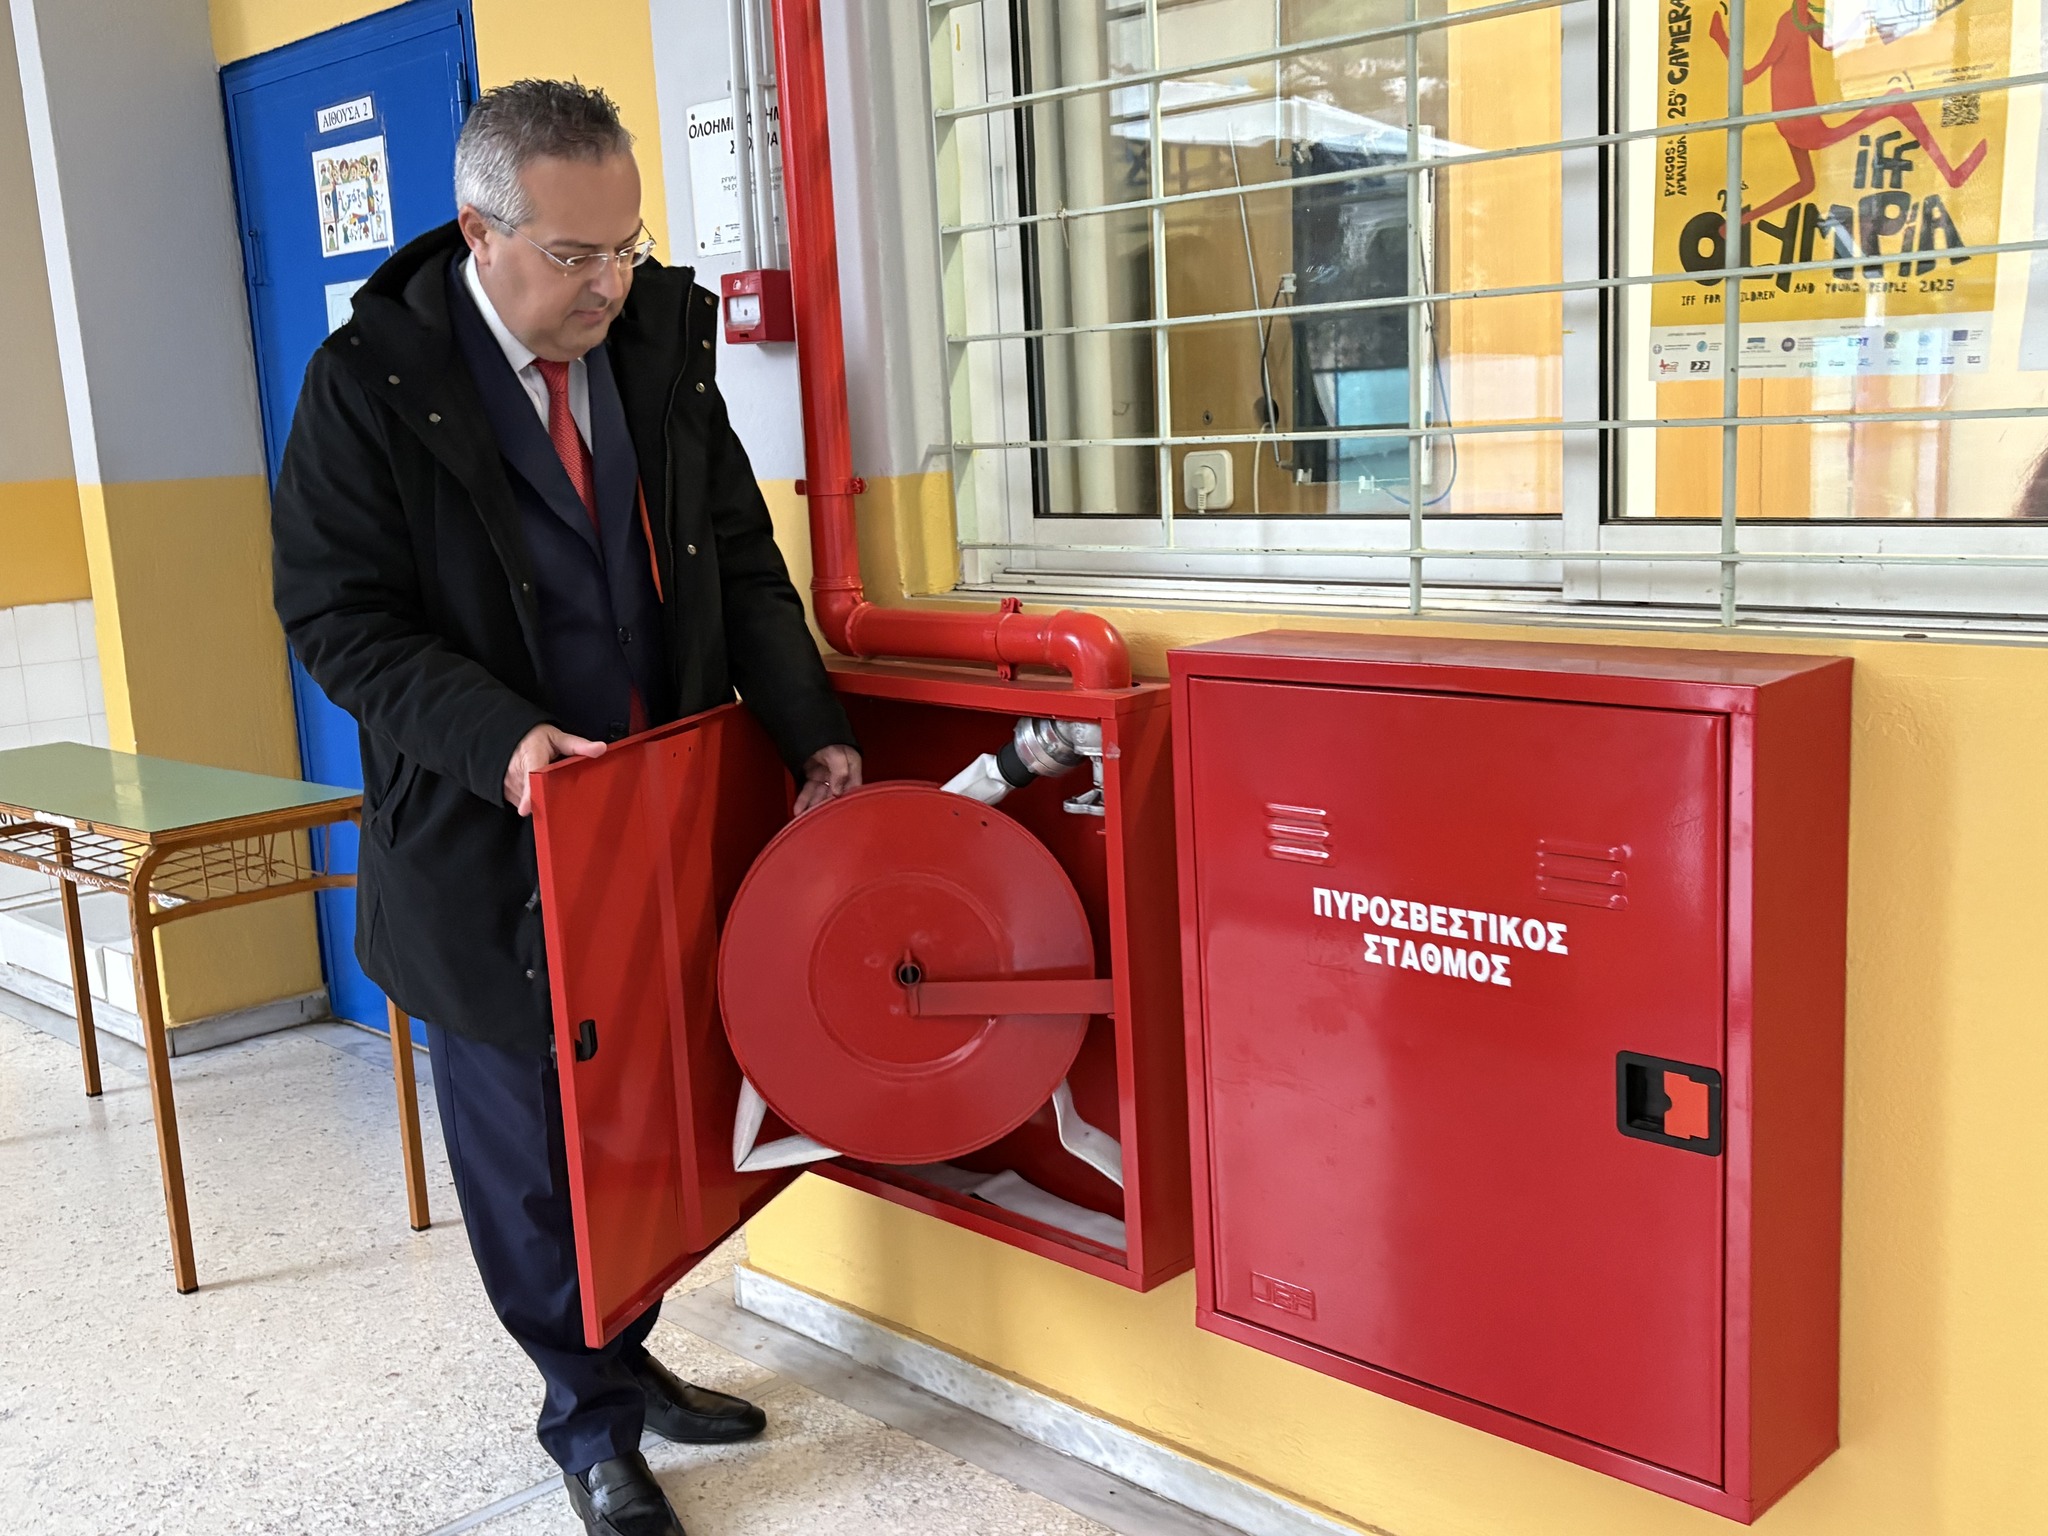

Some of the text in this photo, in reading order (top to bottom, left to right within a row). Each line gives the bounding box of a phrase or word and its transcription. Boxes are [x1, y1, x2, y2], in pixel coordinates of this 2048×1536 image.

[323, 102, 368, 128] ΑΙΘΟΥΣΑ 2
[1664, 147, 1676, 197] PYRGOS
[1681, 295, 1696, 306] IFF
[1704, 294, 1721, 304] FOR
[1740, 291, 1776, 303] ILDREN
[1794, 282, 1815, 294] AND
[1825, 282, 1860, 293] YOUNG
[1869, 281, 1908, 294] PEOPLE
[1313, 887, 1569, 955] ΠΥΡΟΣΒΕΣΤΙΚΟΣ
[1363, 932, 1512, 987] ΣΤΑΘΜΟΣ
